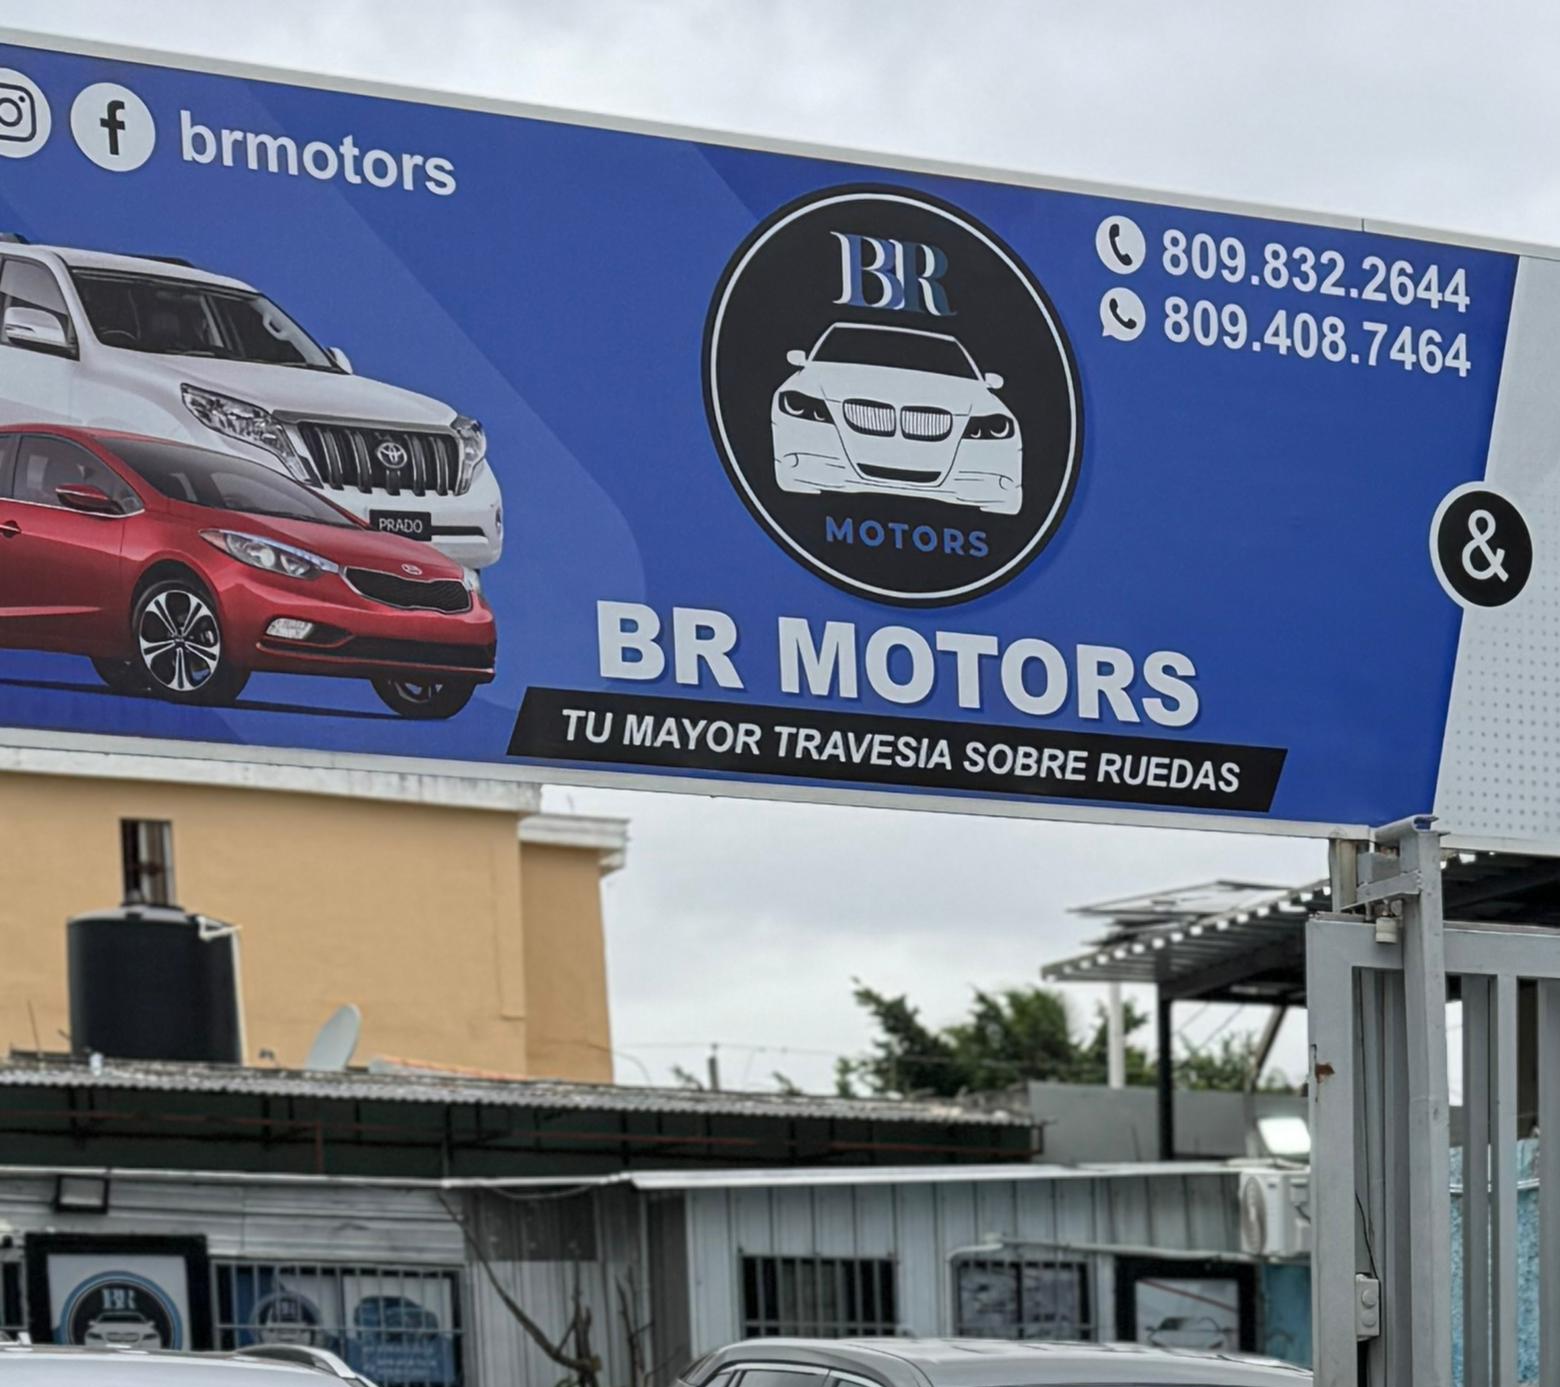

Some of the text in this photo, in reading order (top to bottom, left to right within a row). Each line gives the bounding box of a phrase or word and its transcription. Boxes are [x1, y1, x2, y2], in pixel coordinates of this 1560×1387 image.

[180, 109, 457, 196] brmotors
[829, 230, 957, 318] BR
[1162, 228, 1471, 313] 809.832.2644
[1164, 296, 1472, 378] 809.408.7464
[378, 517, 423, 534] PRADO
[825, 515, 989, 558] MOTORS
[1461, 509, 1509, 582] &
[596, 599, 1199, 727] BR MOTORS
[562, 708, 1240, 793] TU MAYOR TRAVESIA SOBRE RUEDAS
